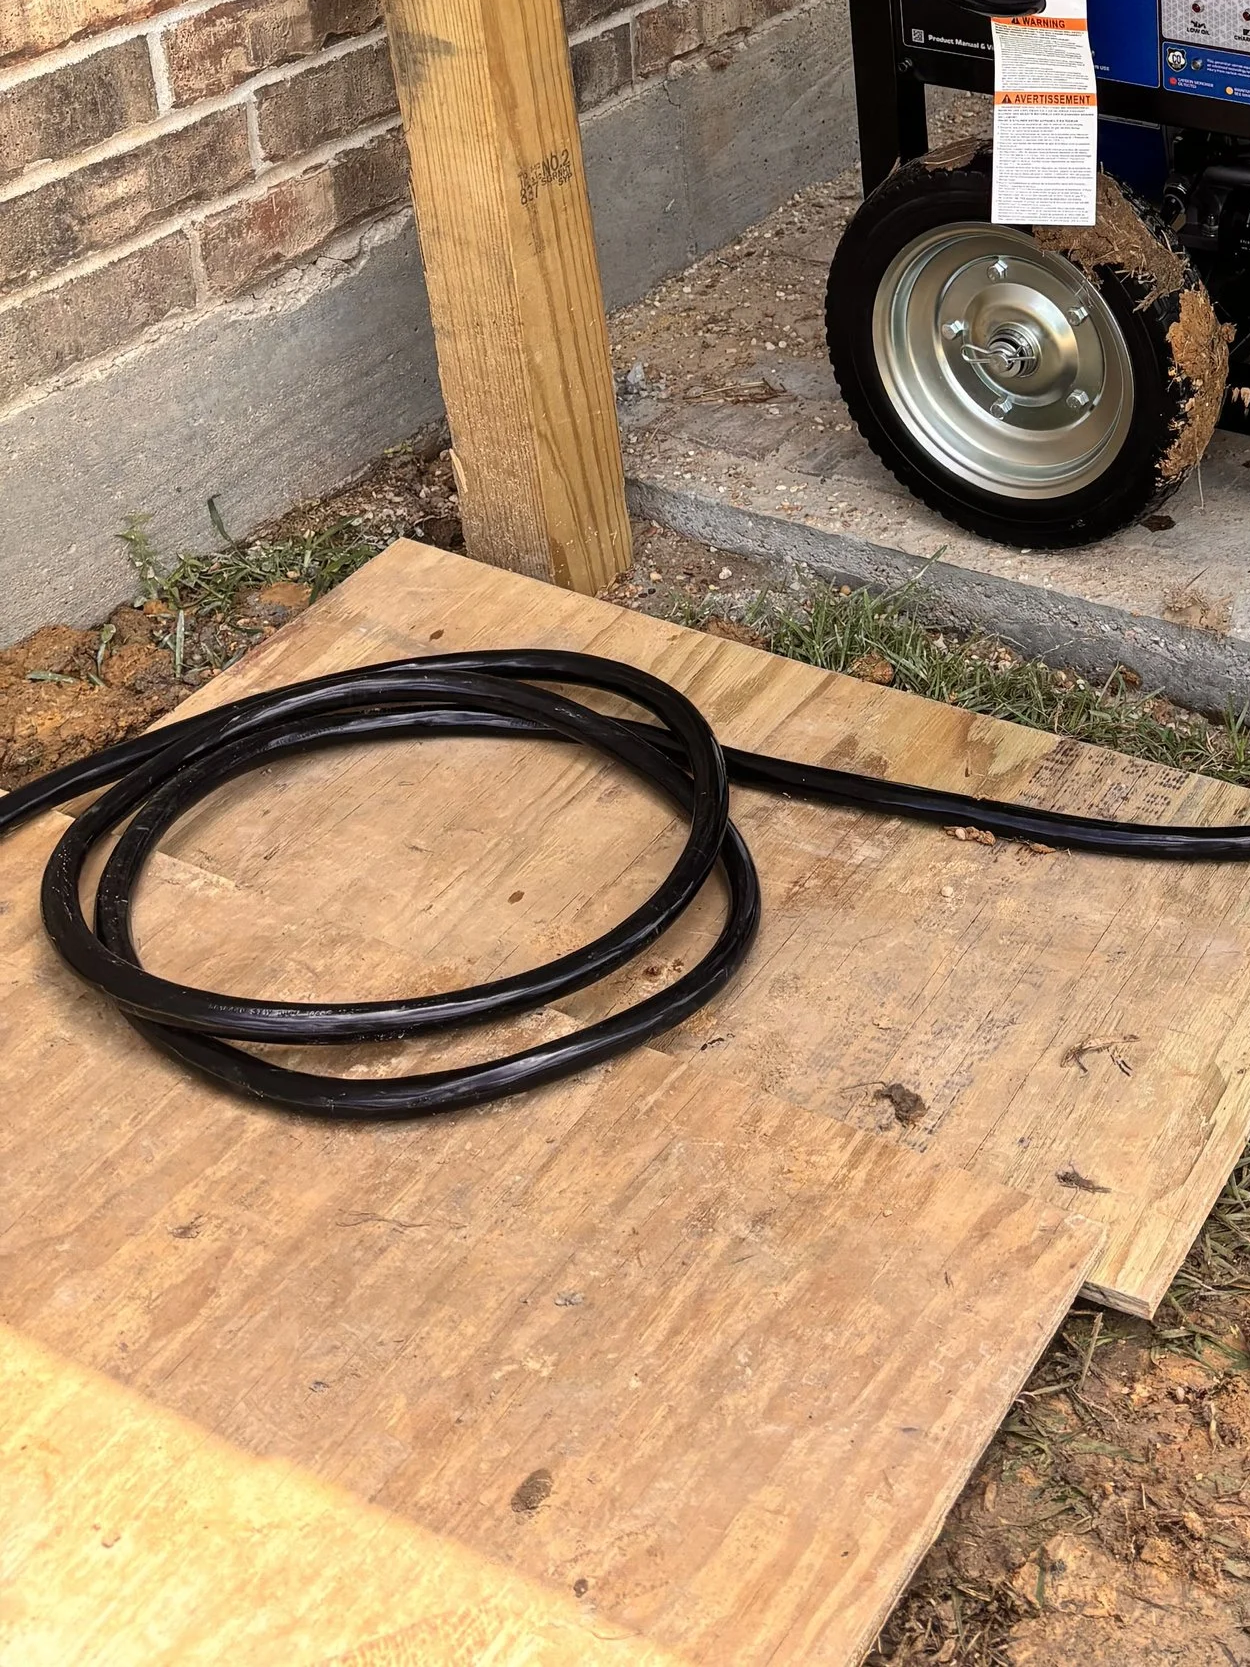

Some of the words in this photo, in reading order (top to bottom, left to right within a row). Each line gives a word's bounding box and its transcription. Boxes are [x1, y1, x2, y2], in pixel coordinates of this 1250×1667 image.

[1022, 17, 1066, 29] WARNING
[928, 34, 954, 45] Product
[955, 38, 979, 49] Manual
[1014, 94, 1091, 105] AVERTISSEMENT
